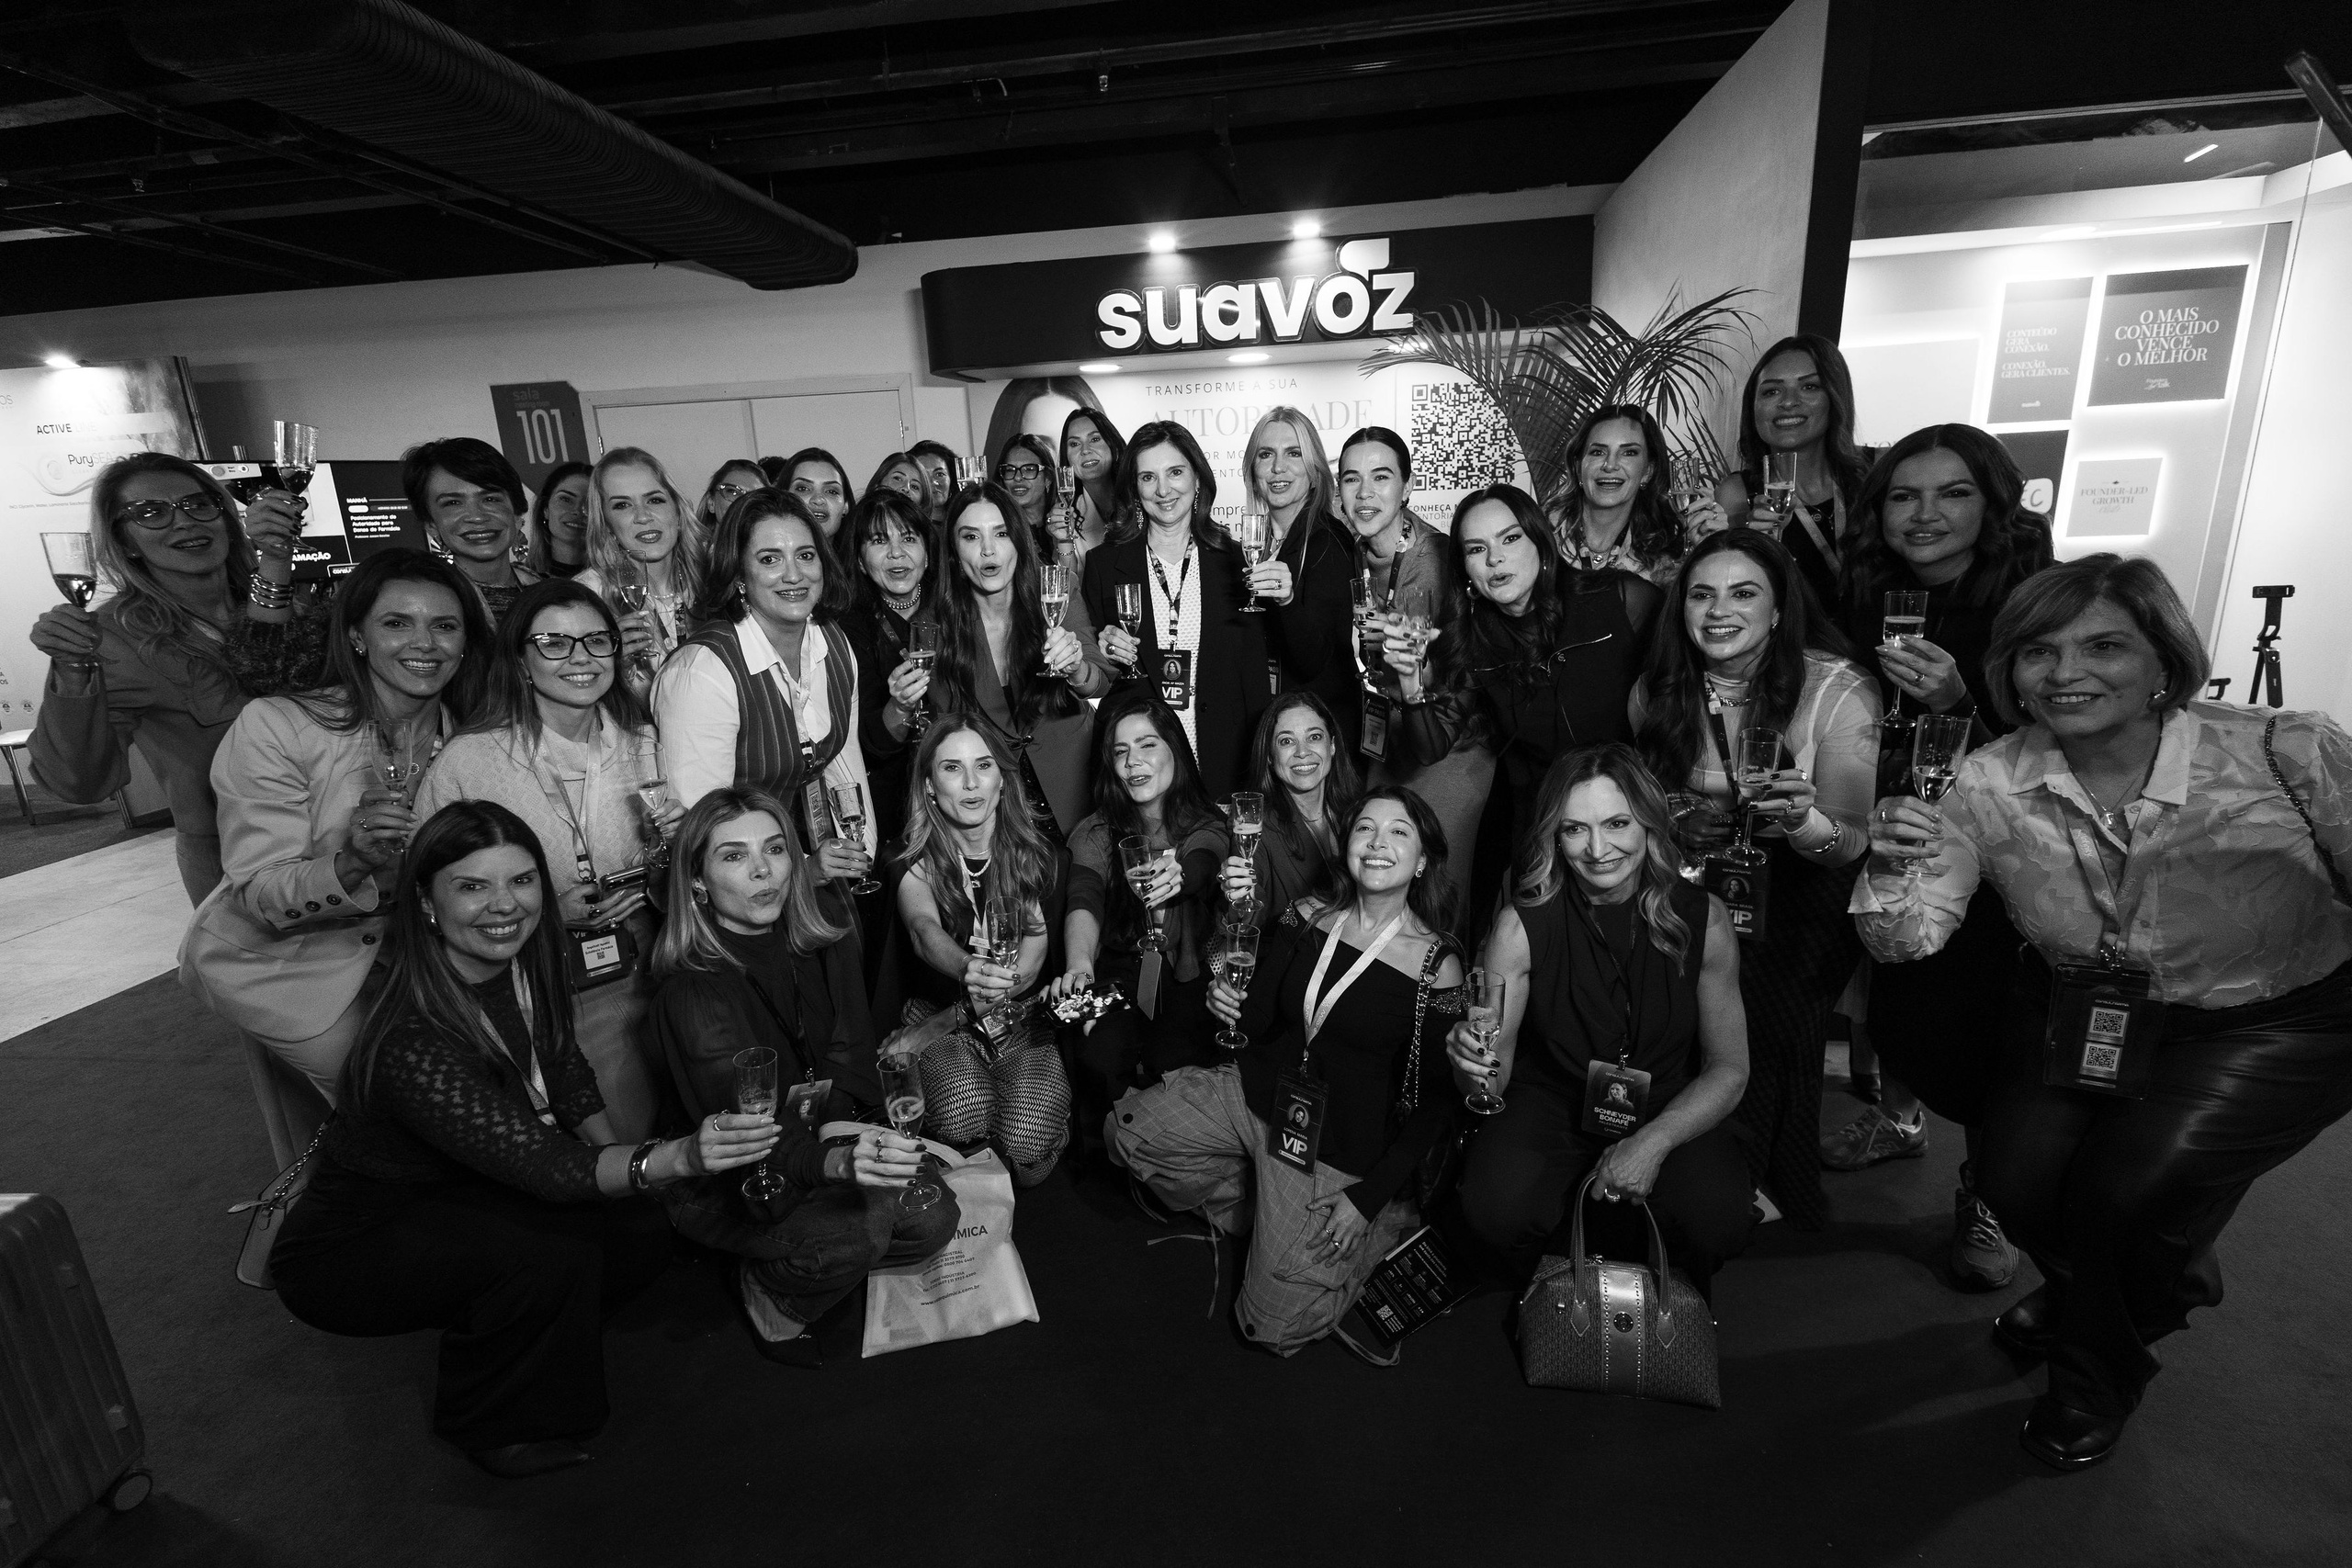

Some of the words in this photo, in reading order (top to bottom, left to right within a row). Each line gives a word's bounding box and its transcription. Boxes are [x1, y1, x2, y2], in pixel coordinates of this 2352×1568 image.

[2140, 310, 2154, 324] O
[2156, 307, 2199, 323] MAIS
[2007, 327, 2057, 337] CONTEÚDO
[2115, 320, 2220, 340] CONHECIDO
[2006, 337, 2030, 345] GERA
[2136, 335, 2194, 352] VENCE
[2117, 352, 2132, 367] O
[2133, 347, 2208, 366] MELHOR
[2001, 370, 2025, 378] GERA
[1146, 380, 1245, 396] TRANSFORME
[1253, 379, 1261, 390] A
[1270, 378, 1298, 389] SUA
[513, 388, 540, 400] sala
[37, 423, 72, 434] ACTIVE
[516, 409, 570, 464] 101
[1204, 451, 1220, 460] OR
[1227, 450, 1246, 460] MO
[2081, 486, 2149, 496] FOUNDER-LED
[2092, 496, 2134, 505] GROWTH
[1213, 506, 1247, 518] mpre
[292, 551, 332, 562] AMAÇÃO
[1161, 686, 1183, 699] VIP
[1729, 909, 1753, 924] IP
[1594, 1106, 1636, 1122] SCHNEYDER
[1283, 1126, 1296, 1135] LORENA
[1296, 1132, 1308, 1140] MARIA
[1283, 1133, 1307, 1155] VIP
